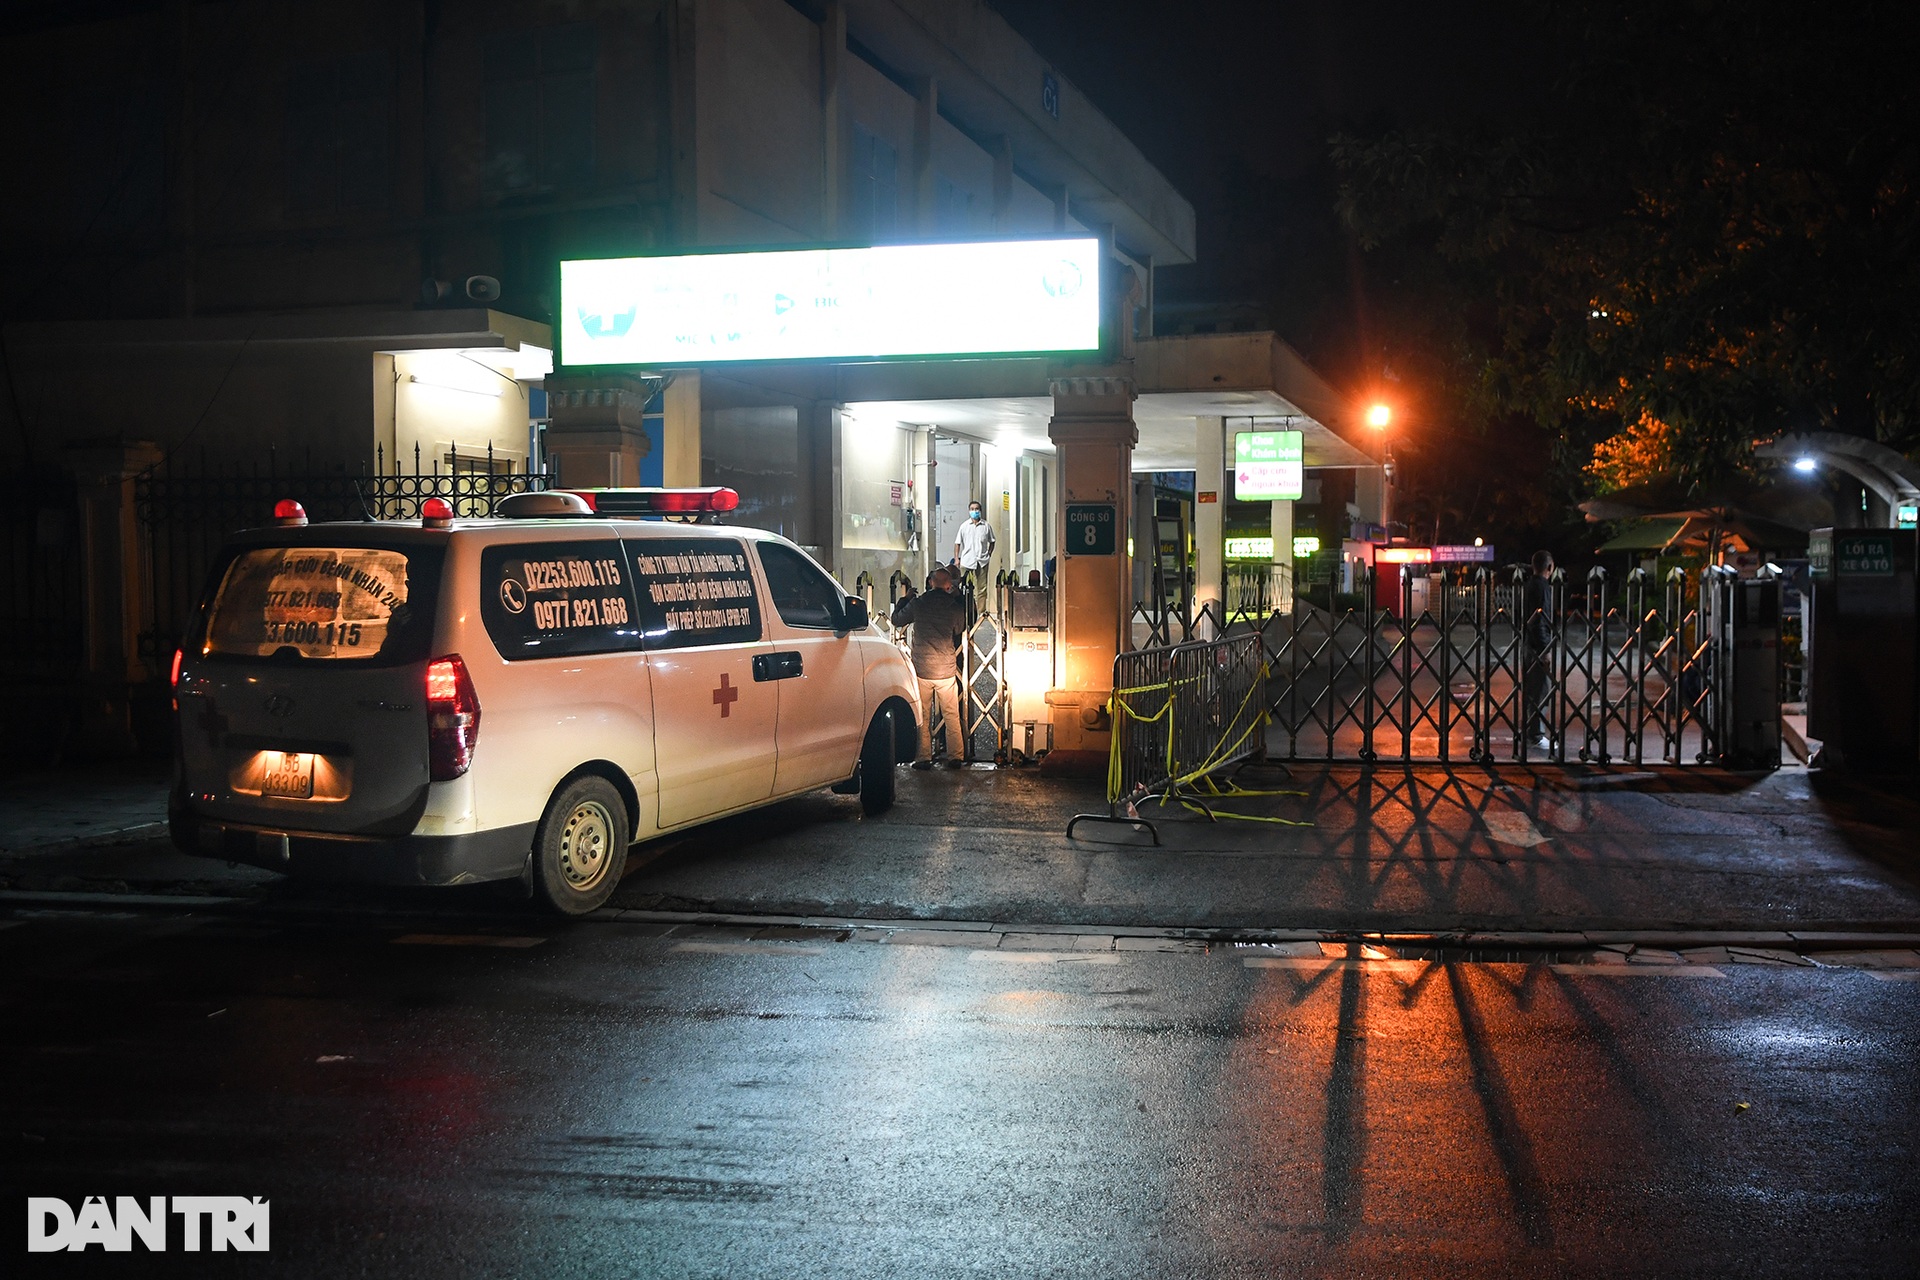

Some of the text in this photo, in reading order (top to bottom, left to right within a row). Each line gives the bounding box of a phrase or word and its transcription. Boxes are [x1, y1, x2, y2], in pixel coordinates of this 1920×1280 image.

[1097, 508, 1110, 523] SỐ
[1084, 524, 1097, 546] 8
[1846, 540, 1884, 555] LỐI RA
[654, 556, 665, 574] TY
[1843, 559, 1857, 570] XE
[1860, 556, 1870, 570] Ô
[1873, 556, 1889, 570] TÔ
[351, 570, 386, 599] NHÂN
[523, 559, 621, 589] 02253.600.115
[534, 597, 629, 629] 0977.821.668
[279, 752, 300, 773] 15B
[264, 772, 309, 793] 033.09
